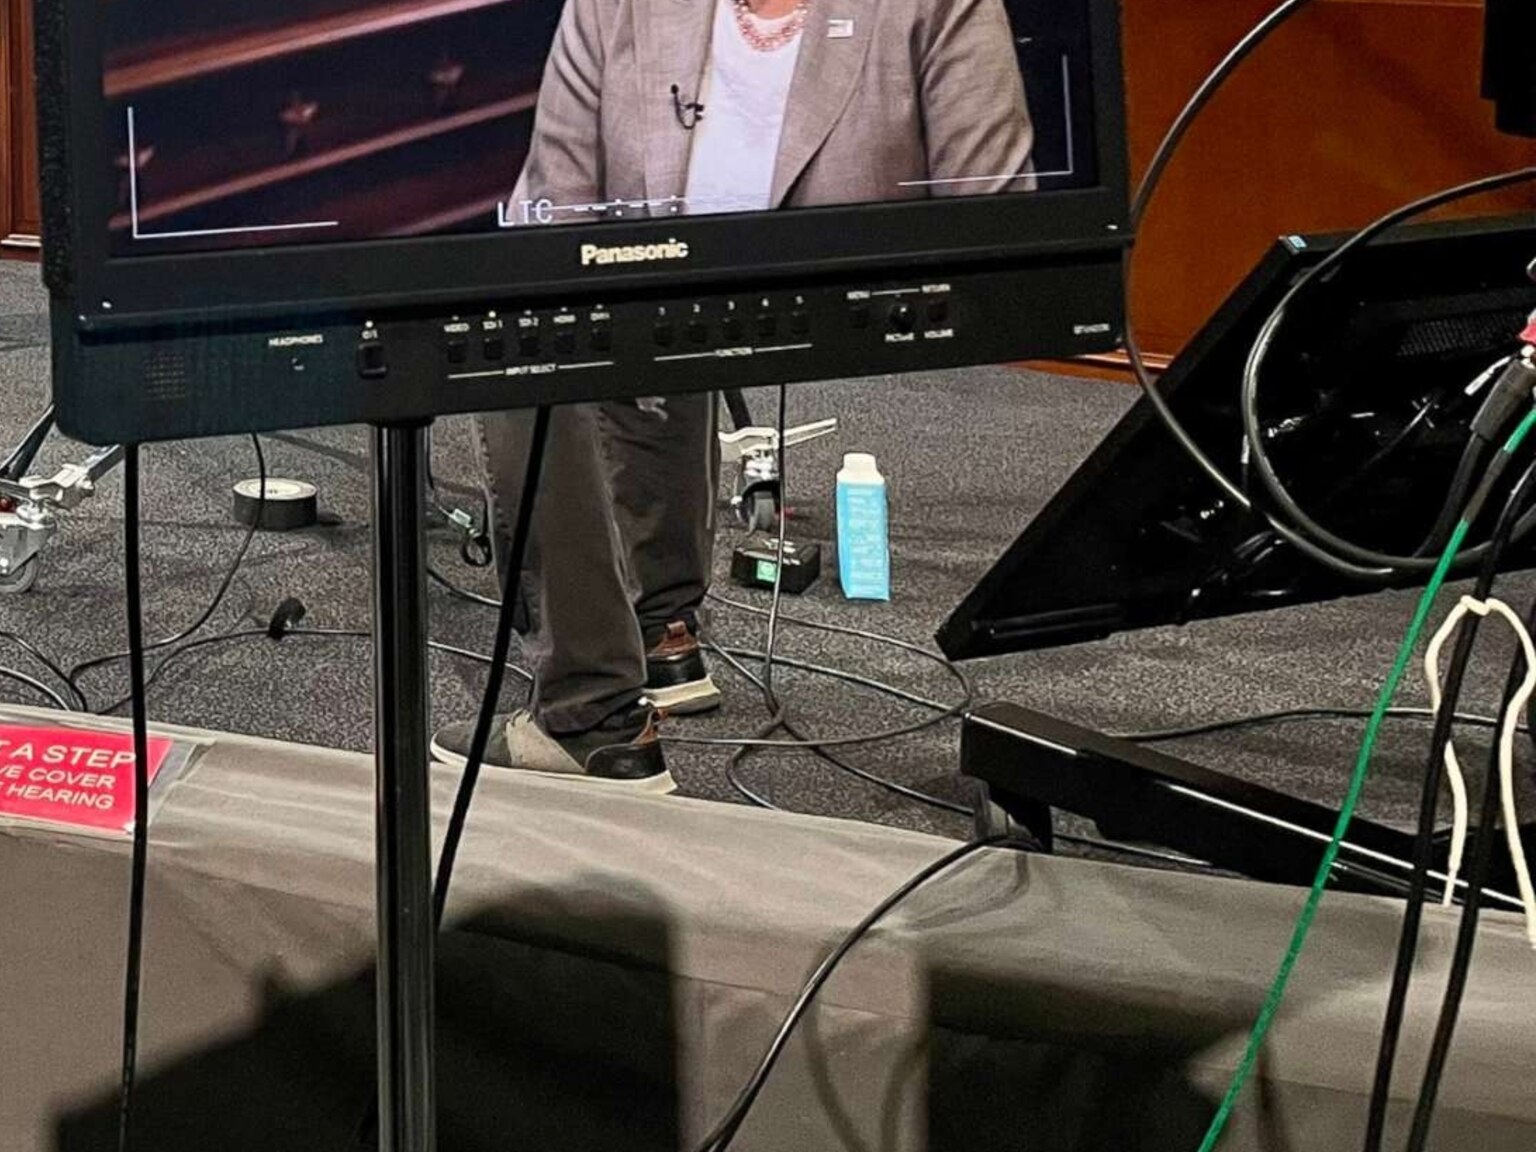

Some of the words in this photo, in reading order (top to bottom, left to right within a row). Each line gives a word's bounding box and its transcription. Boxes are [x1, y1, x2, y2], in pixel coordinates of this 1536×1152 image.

[581, 238, 689, 266] Panasonic
[11, 742, 34, 760] A
[42, 745, 136, 769] STEP
[28, 766, 117, 790] COVER
[5, 783, 116, 811] HEARING
